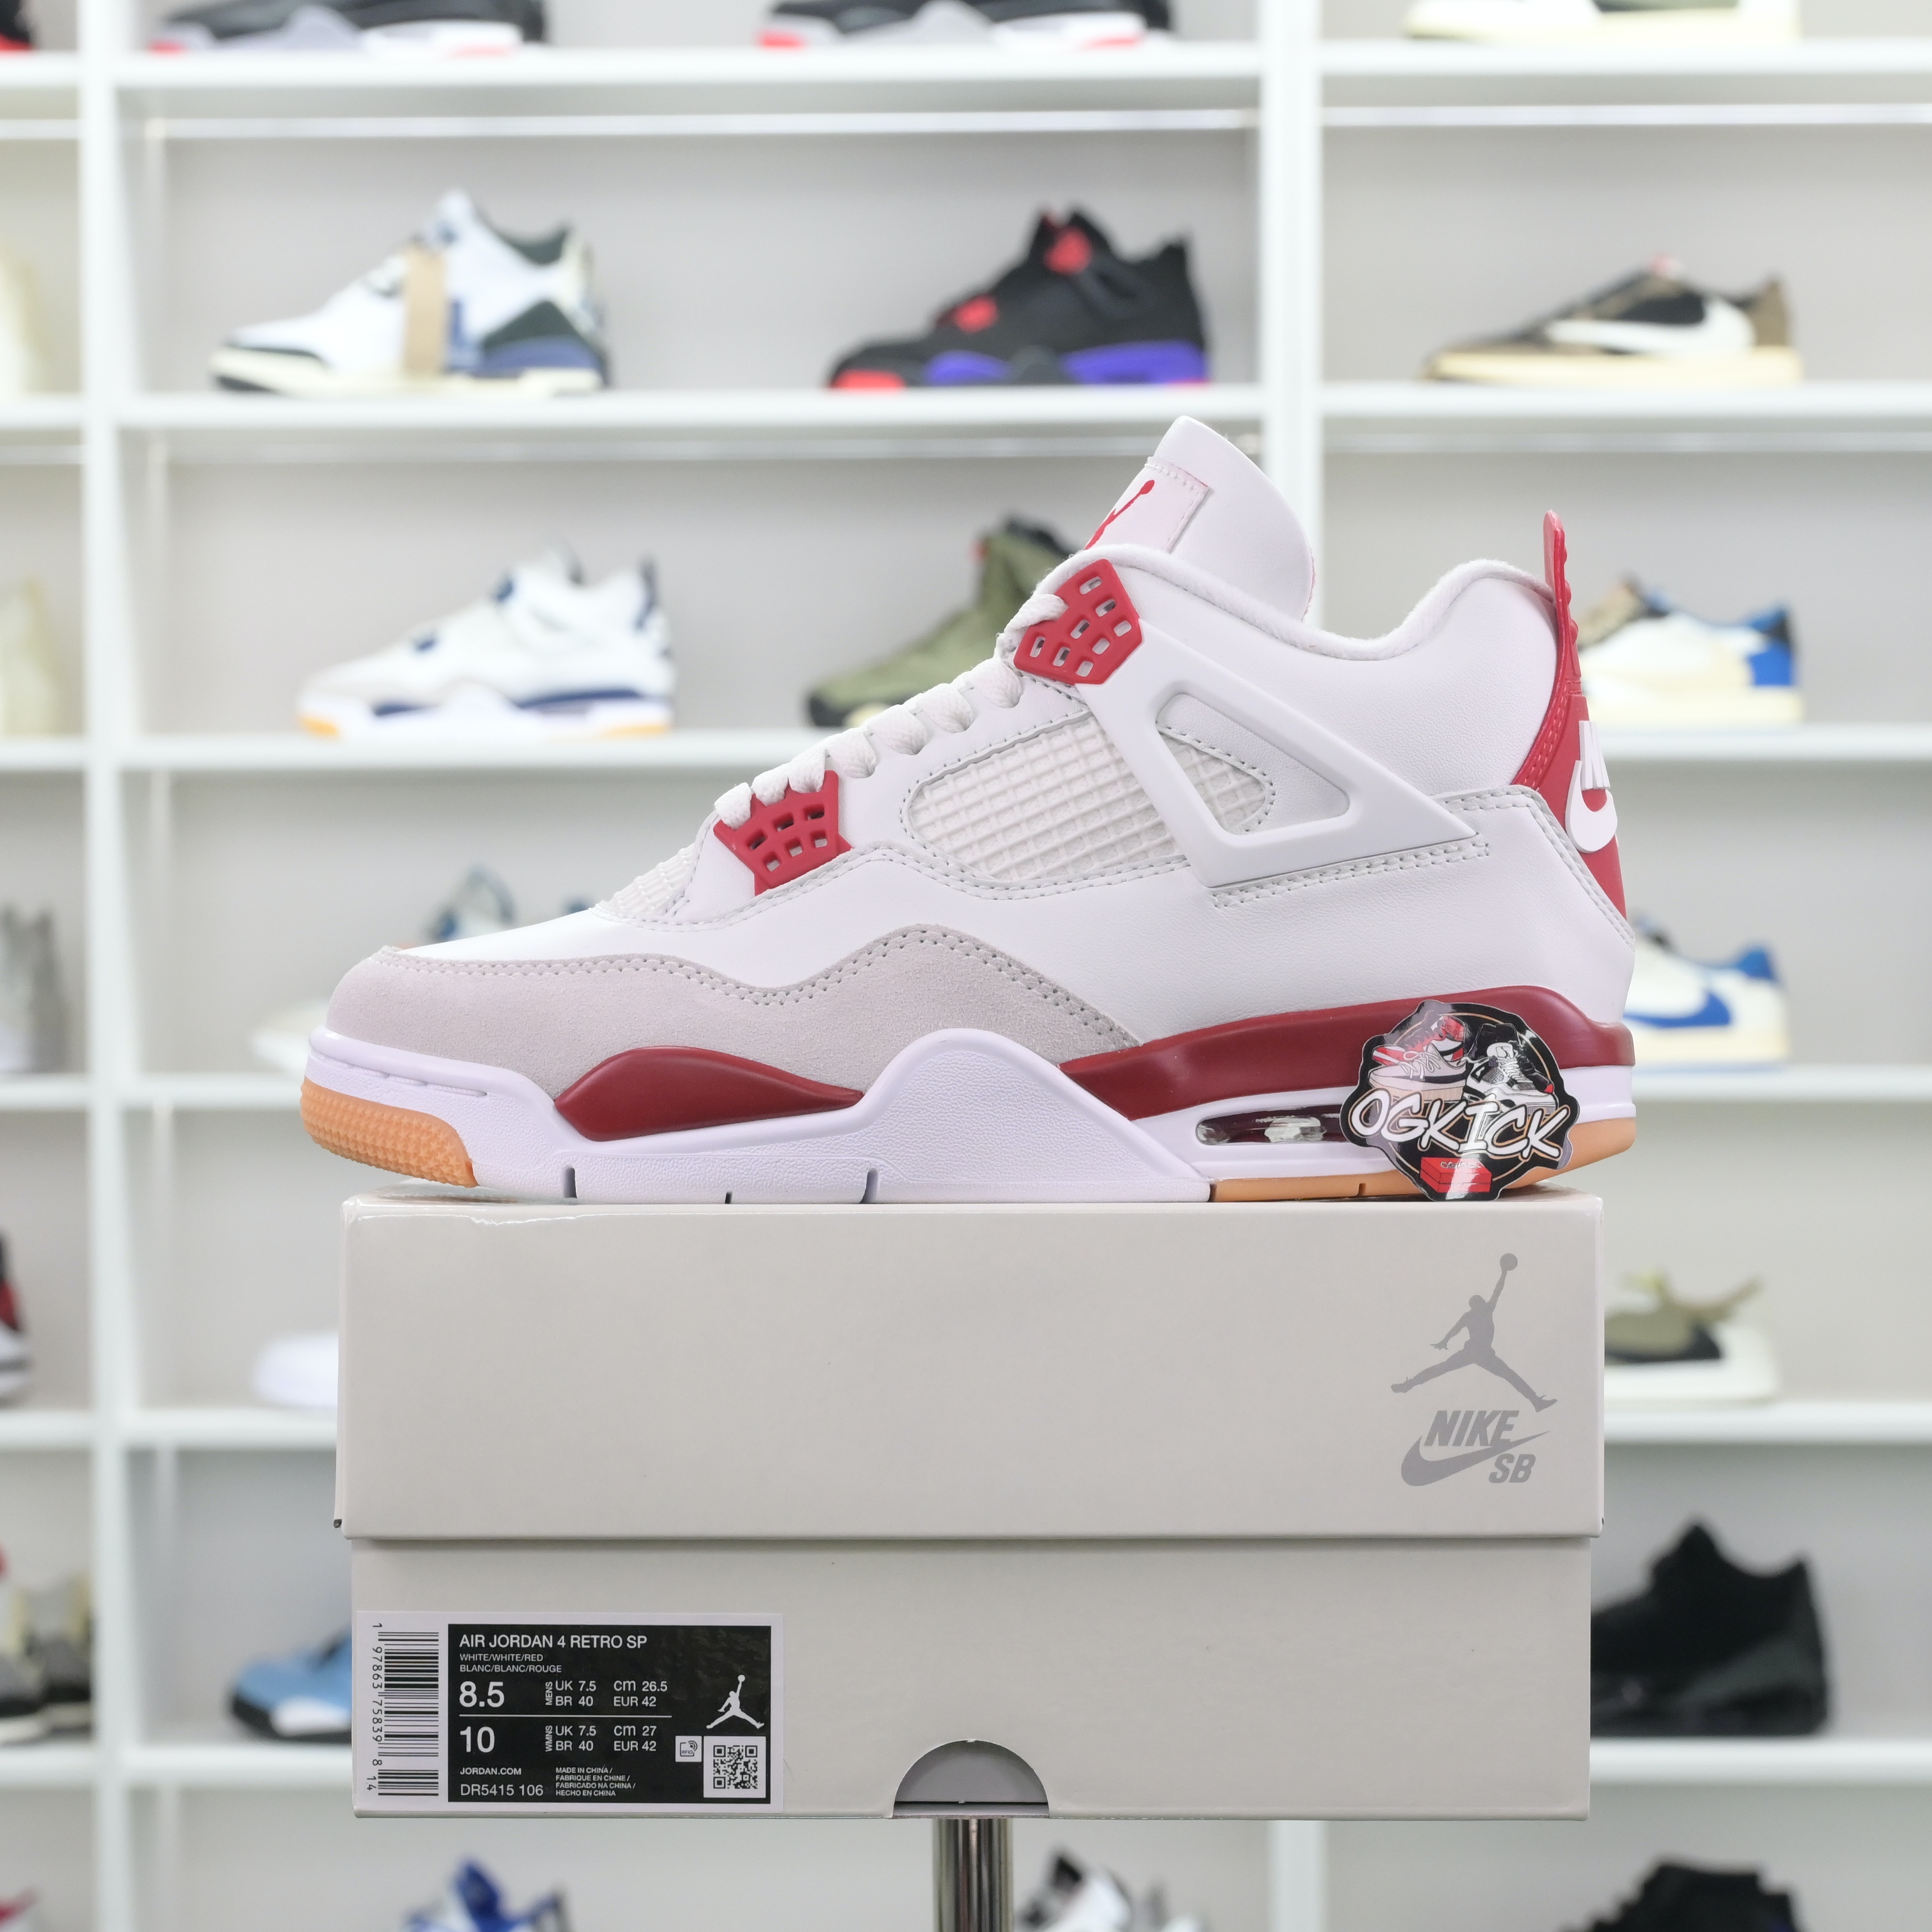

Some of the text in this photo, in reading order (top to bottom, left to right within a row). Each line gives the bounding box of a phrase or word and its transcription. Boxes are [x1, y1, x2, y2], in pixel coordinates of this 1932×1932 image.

[1348, 1087, 1571, 1161] OGKICK
[1423, 1410, 1519, 1447] NIKE
[1488, 1453, 1536, 1484] SB
[460, 1634, 647, 1648] AIR JORDAN 4 RETRO SP
[372, 1645, 384, 1690] 97863
[556, 1680, 596, 1692] UK 7.5
[642, 1681, 667, 1692] 26.5
[460, 1681, 504, 1707] 8.5
[556, 1696, 593, 1706] BR 40
[614, 1696, 656, 1707] EUR 42
[372, 1698, 384, 1743] 75839
[556, 1725, 596, 1736] UK 7.5
[642, 1725, 657, 1736] 27
[460, 1727, 494, 1752] 10
[556, 1740, 593, 1751] BR 40
[614, 1740, 656, 1751] EUR 42
[372, 1758, 384, 1767] 8
[461, 1784, 543, 1796] DR5415 106
